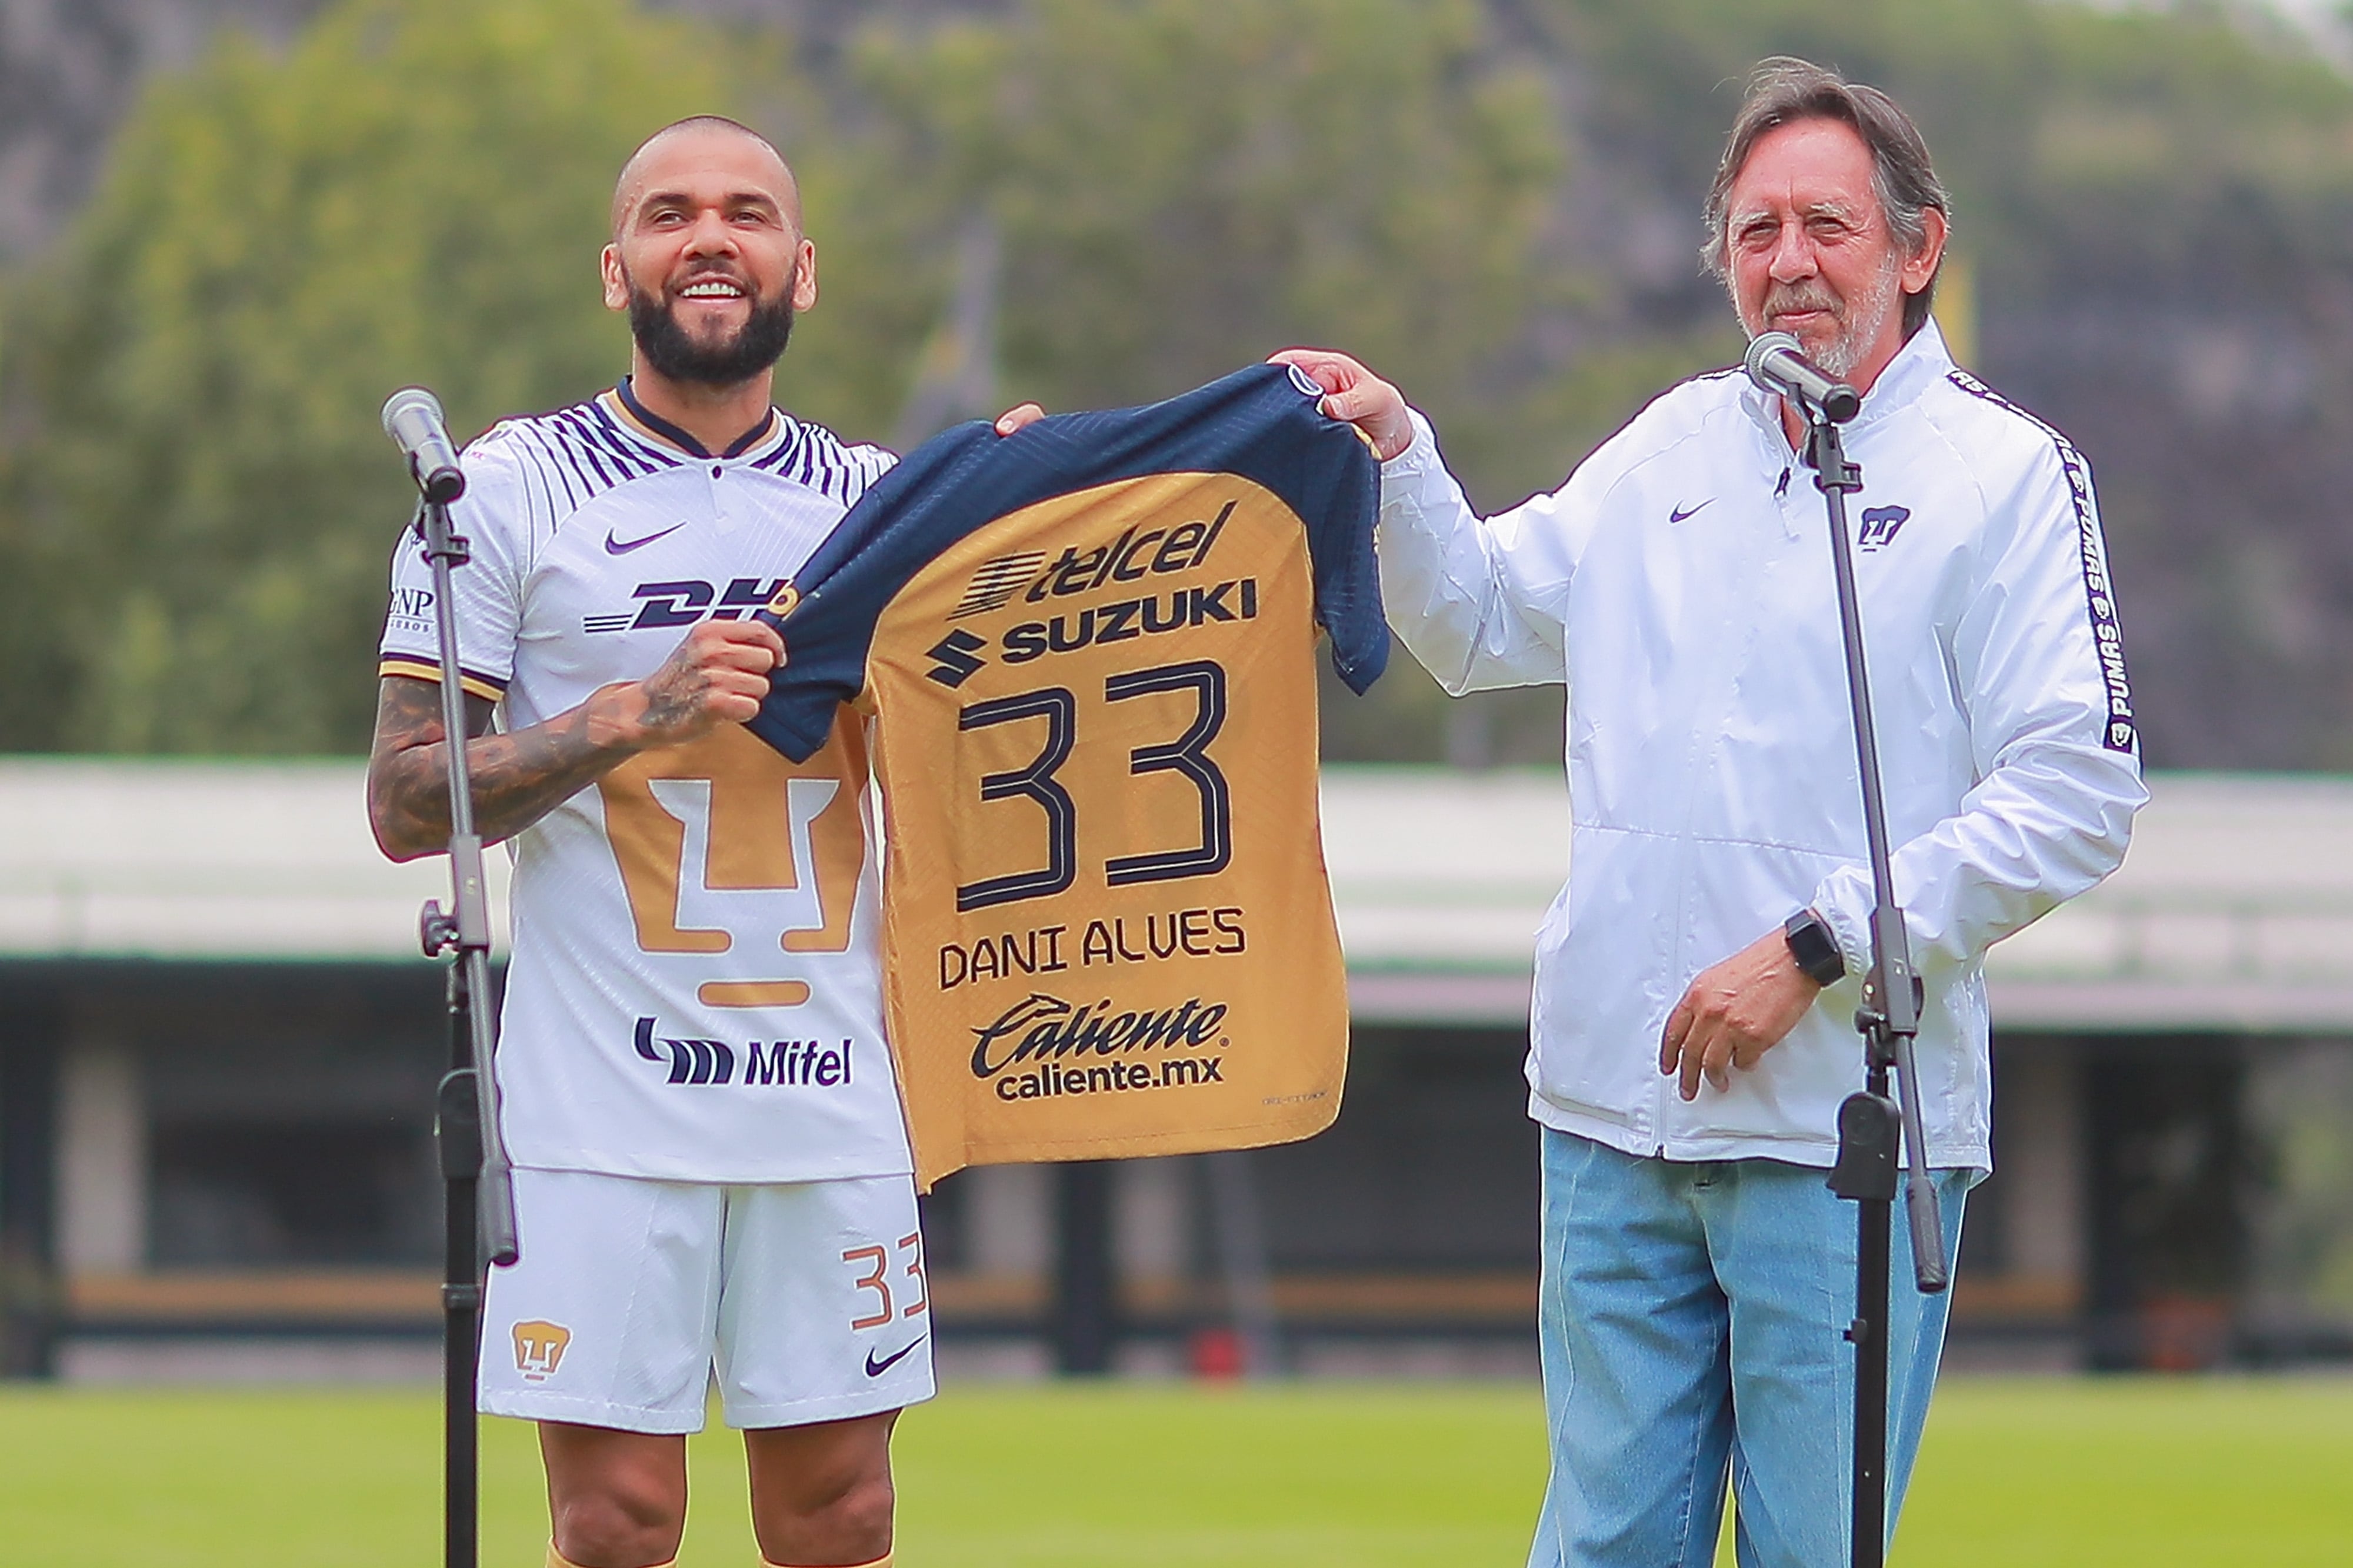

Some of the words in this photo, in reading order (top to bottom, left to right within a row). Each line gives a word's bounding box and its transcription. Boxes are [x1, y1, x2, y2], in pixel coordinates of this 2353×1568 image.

[1024, 499, 1238, 604] telcel
[2074, 496, 2104, 593] PUMAS
[632, 578, 789, 629] DH
[1001, 578, 1258, 666] SUZUKI
[2097, 622, 2134, 717] PUMAS
[956, 659, 1232, 913] 33
[939, 925, 1068, 990] DANI
[1083, 908, 1247, 966] ALVES
[744, 1038, 854, 1086] Mifel
[971, 992, 1229, 1079] Caliente
[996, 1056, 1225, 1102] caliente.mx
[842, 1232, 926, 1331] 33
